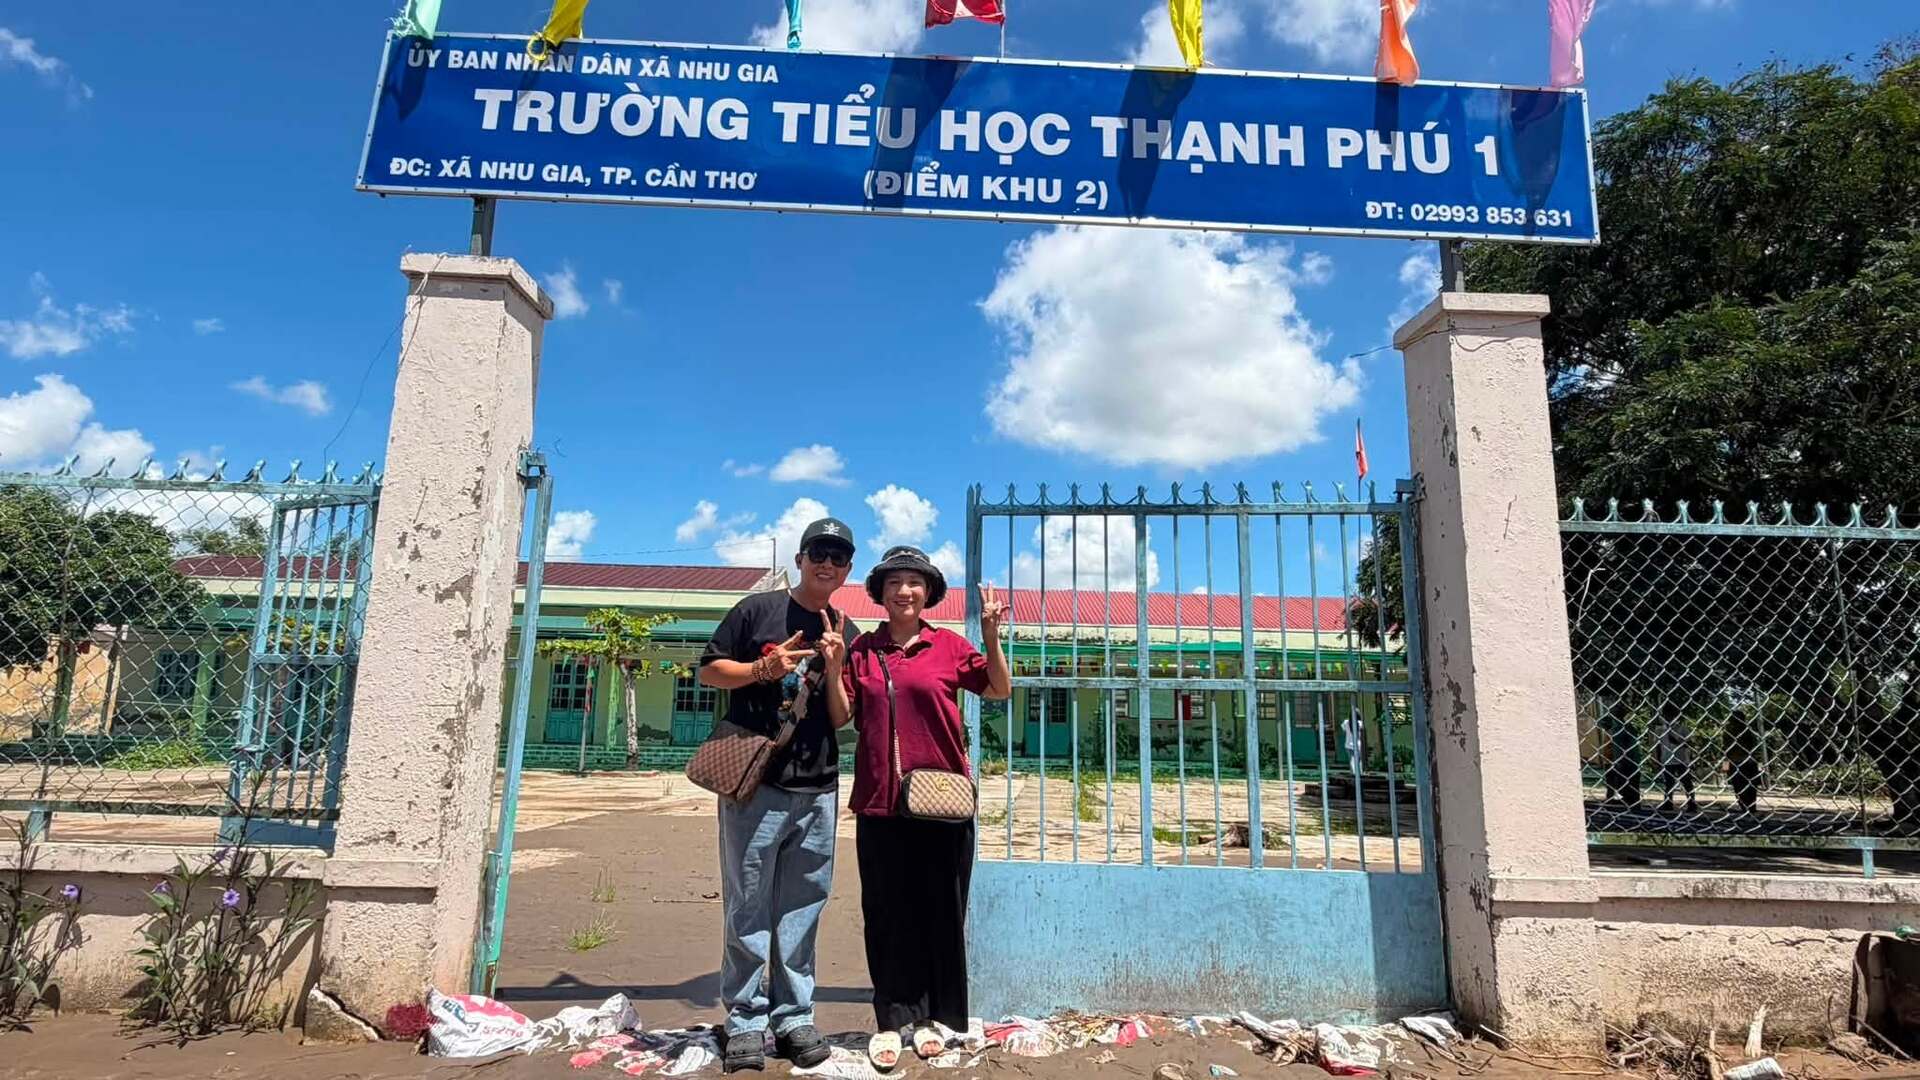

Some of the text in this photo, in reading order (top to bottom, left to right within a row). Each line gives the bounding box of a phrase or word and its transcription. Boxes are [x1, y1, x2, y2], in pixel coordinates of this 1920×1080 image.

[408, 42, 442, 68] ỦY
[448, 50, 498, 70] BAN
[580, 52, 632, 76] DÂN
[638, 56, 671, 78] XÃ
[678, 61, 731, 81] NHU
[737, 63, 779, 83] GIA
[474, 82, 1499, 176] TRƯỜNG TIỂU HỌC THẠNH PHÚ 1
[389, 155, 758, 191] ĐC: XÃ NHU GIA, TP. CẦN THƠ
[863, 161, 1109, 210] (ĐIỂM KHU 2)
[1365, 201, 1573, 227] ĐT: 02993 853 631
